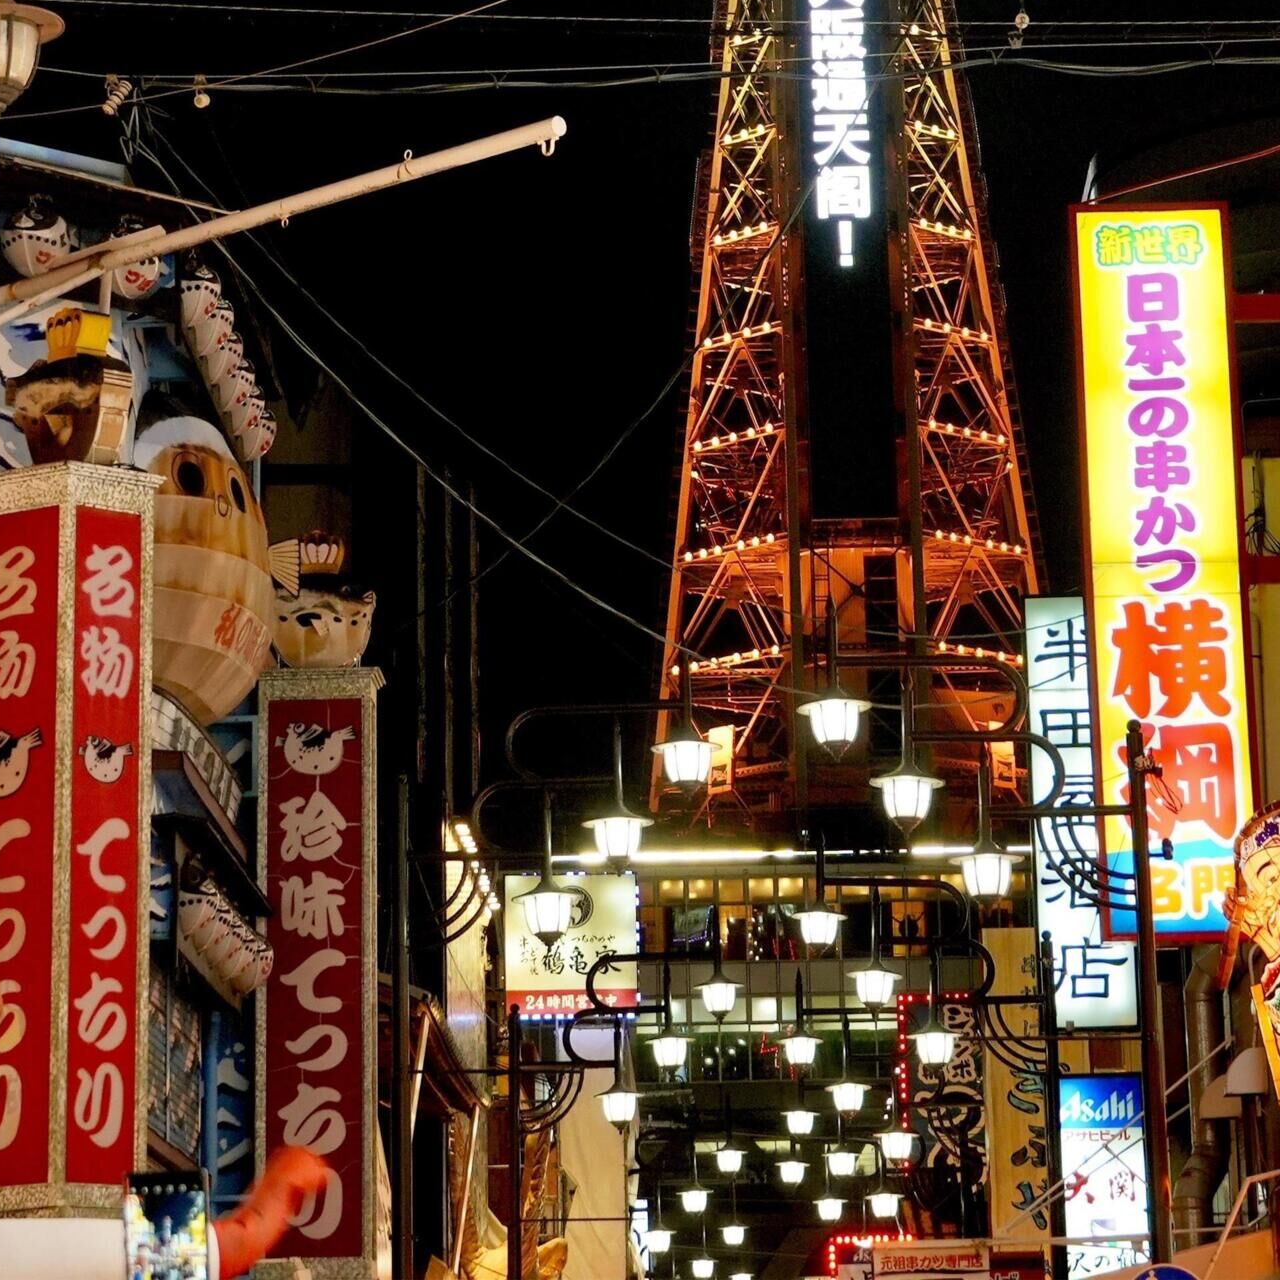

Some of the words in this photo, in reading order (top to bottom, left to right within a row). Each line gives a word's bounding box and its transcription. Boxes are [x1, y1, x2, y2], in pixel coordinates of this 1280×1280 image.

[1097, 224, 1205, 266] 新世界
[1124, 272, 1197, 593] 日本一の串かつ
[80, 543, 136, 699] 名物
[525, 993, 618, 1011] 24時間営中
[1060, 1090, 1134, 1123] Asahi
[880, 1255, 983, 1271] 元祖串カツ専門店
